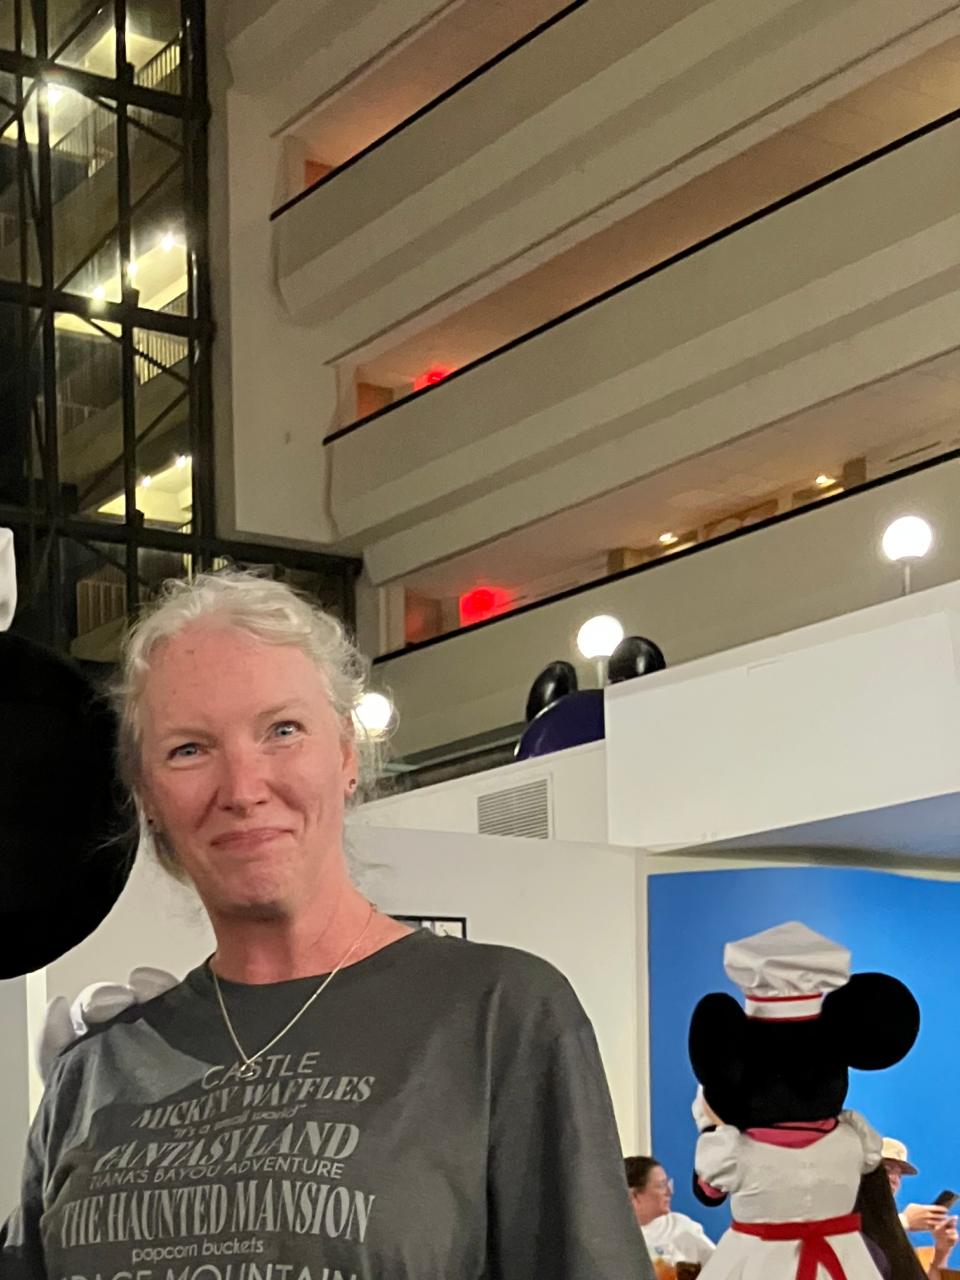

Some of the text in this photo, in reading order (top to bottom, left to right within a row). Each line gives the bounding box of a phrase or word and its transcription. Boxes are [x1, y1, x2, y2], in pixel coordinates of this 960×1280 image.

[201, 1051, 321, 1090] CASTLE
[241, 1075, 376, 1107] WAFFLES
[93, 1120, 361, 1174] FANTASYLAND
[153, 1165, 221, 1184] BAYOU
[224, 1155, 346, 1180] ADVENTURE
[61, 1178, 376, 1249] THE HAUNTED MANSION
[132, 1237, 264, 1265] popcorn buckets
